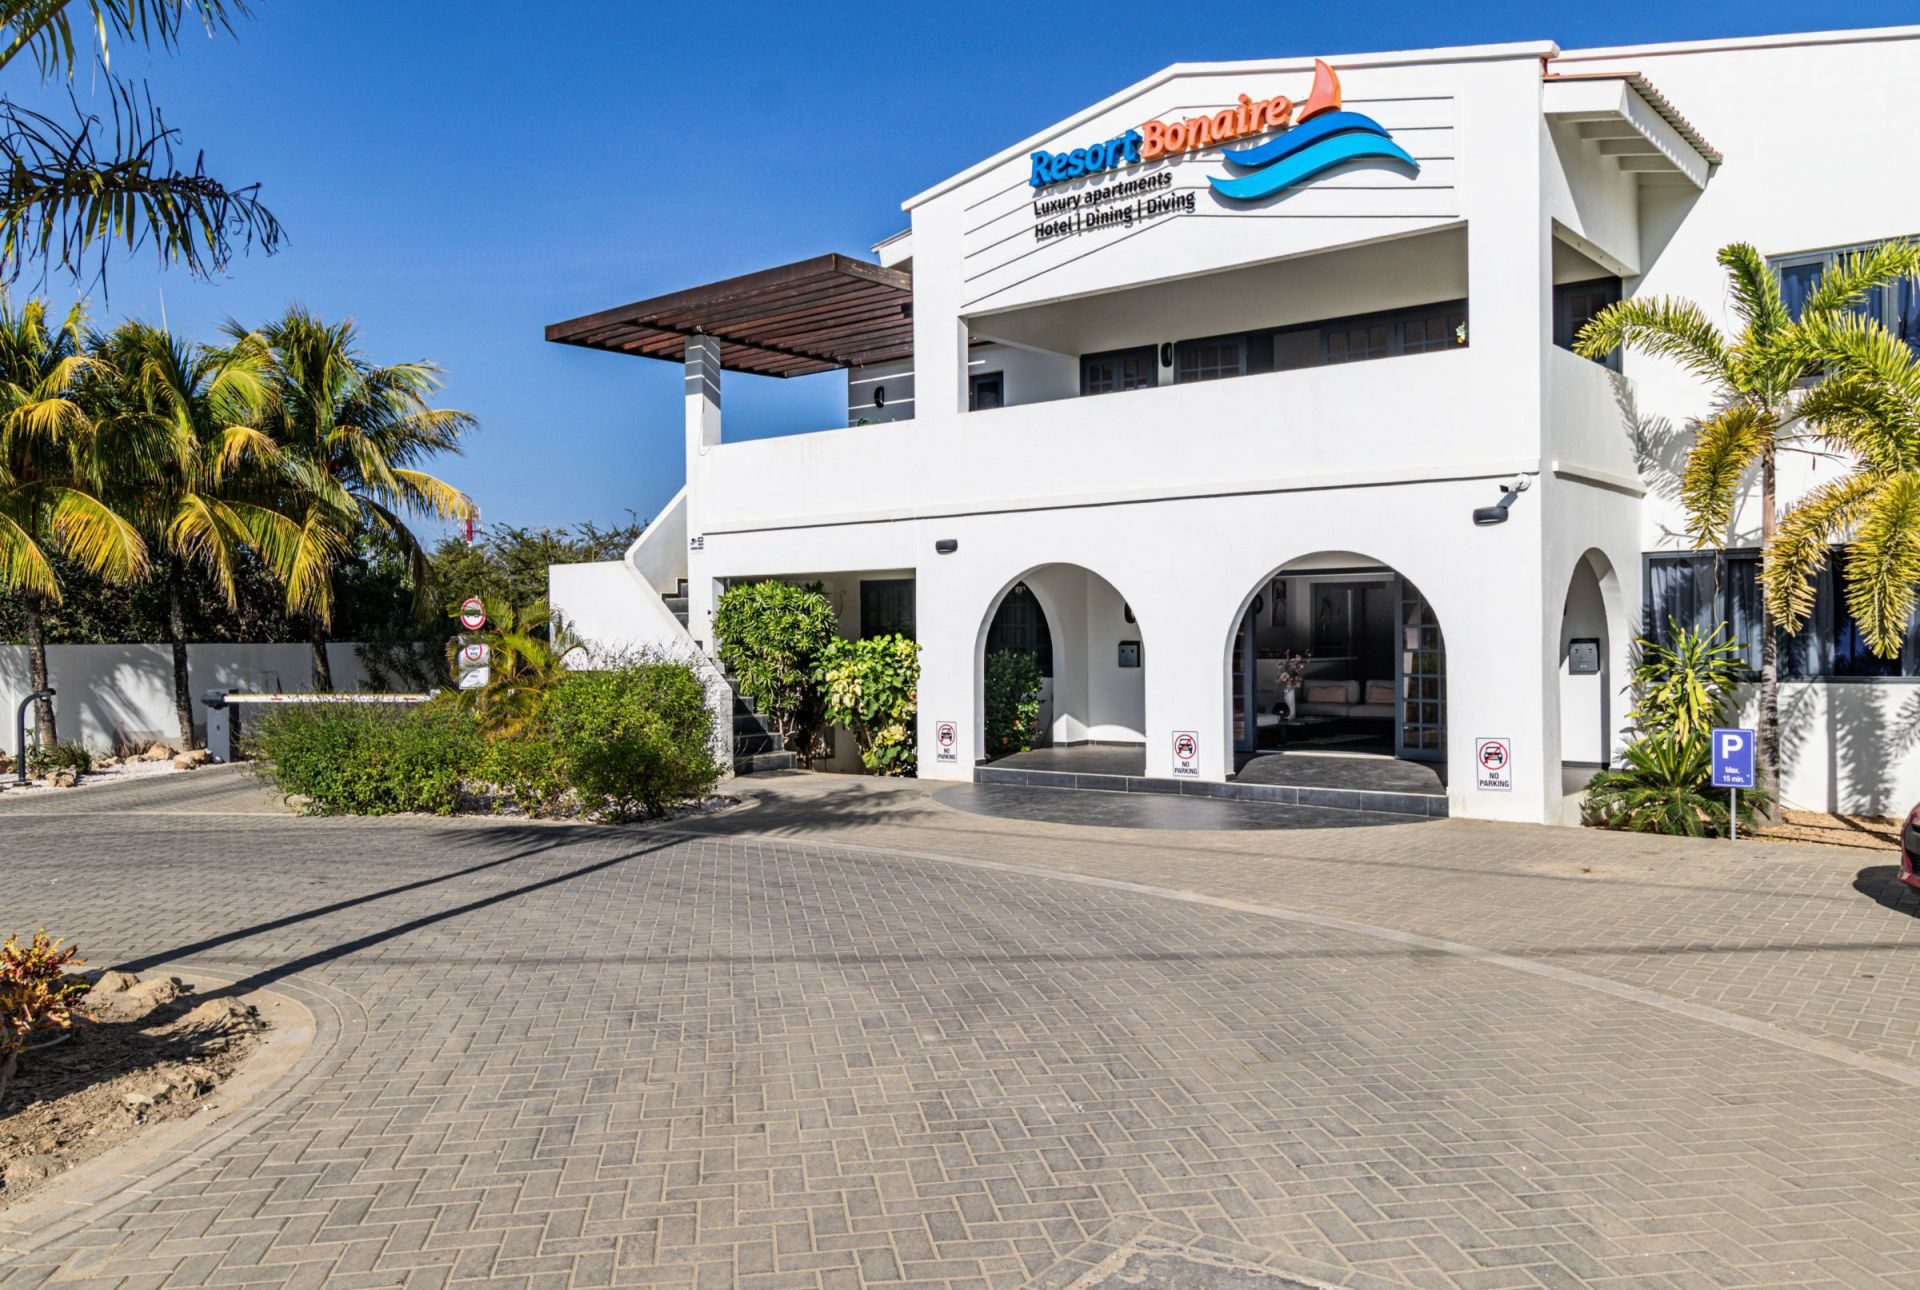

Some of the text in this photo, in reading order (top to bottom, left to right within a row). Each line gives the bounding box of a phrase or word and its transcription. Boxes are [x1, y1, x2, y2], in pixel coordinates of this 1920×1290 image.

[1029, 93, 1293, 189] Resort Bonaire
[1033, 171, 1172, 217] Luxury apartments
[1034, 215, 1073, 238] Hotel
[1086, 205, 1133, 228] Dining
[1147, 191, 1195, 214] Diving
[1722, 734, 1743, 759] P
[1174, 767, 1198, 775] PARKING
[1489, 772, 1499, 780] NO
[1725, 766, 1740, 774] Max.
[1723, 775, 1745, 783] 15 min.
